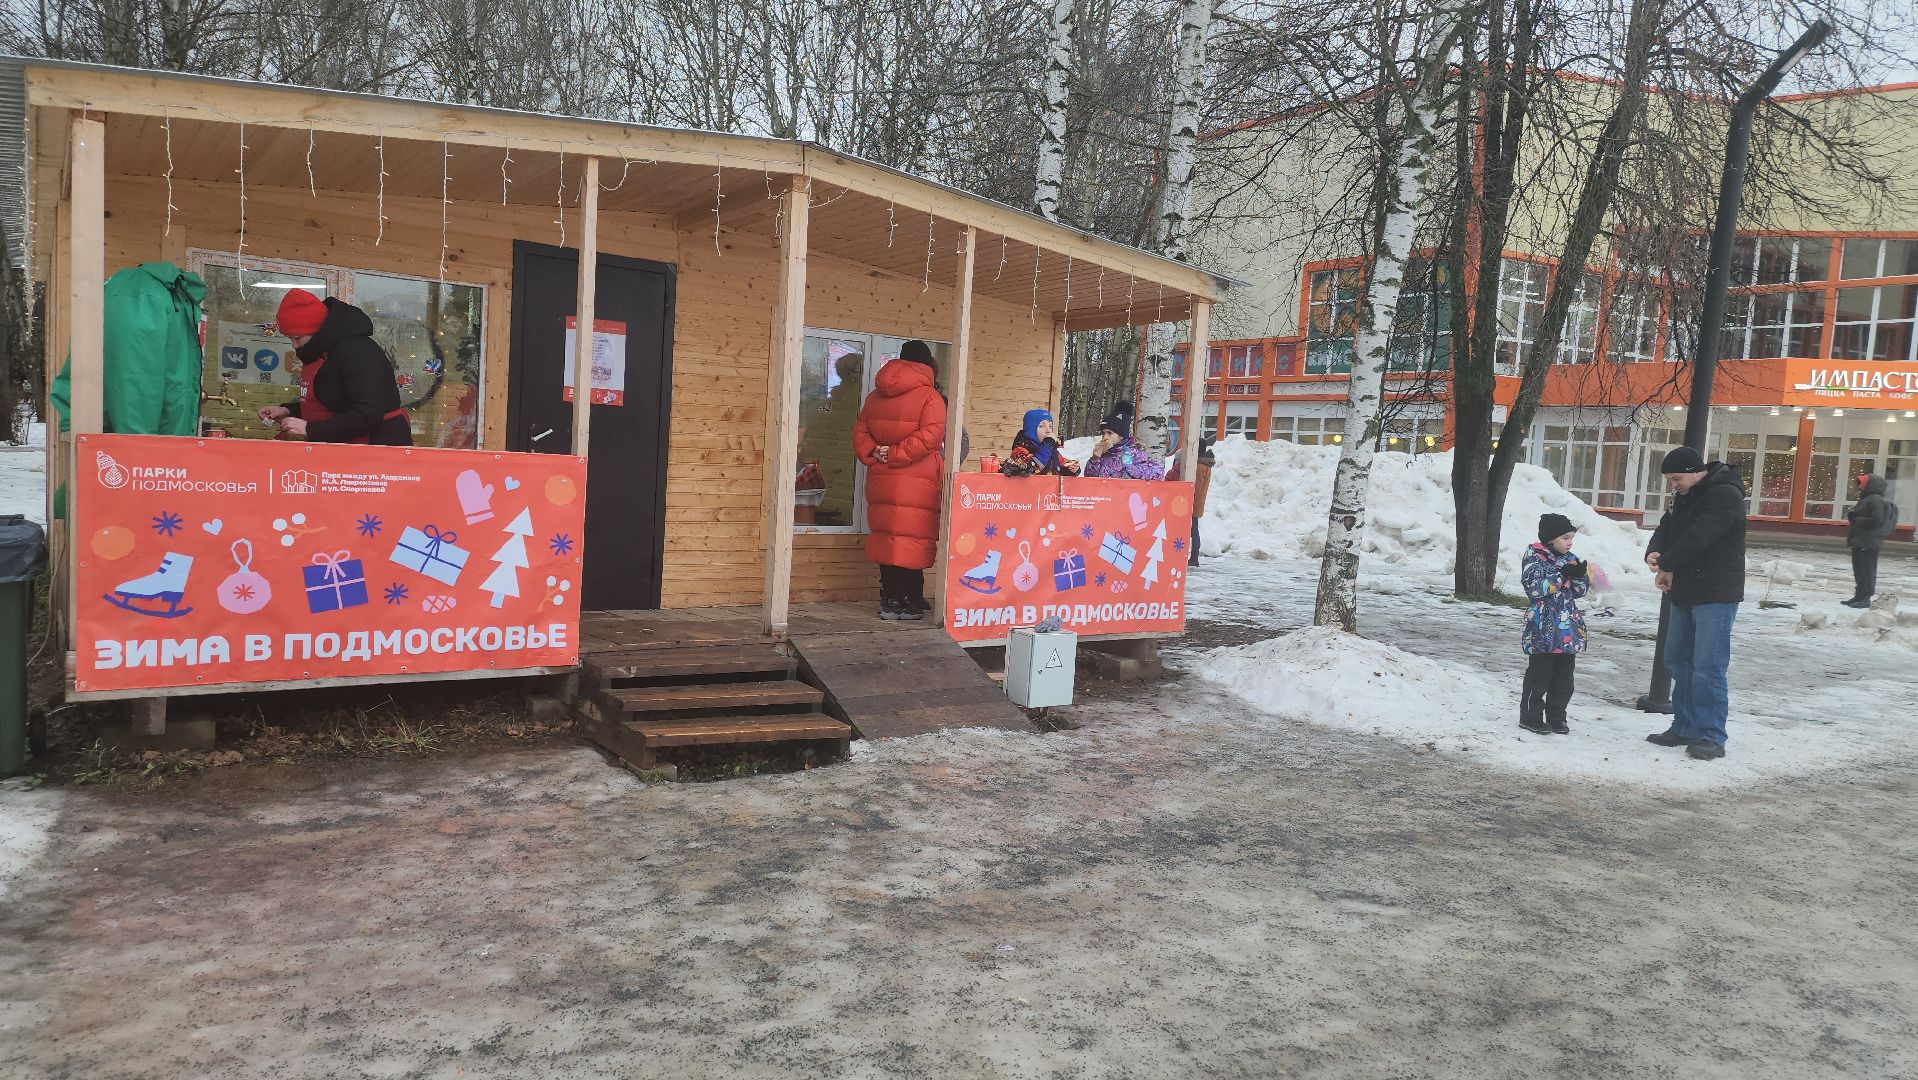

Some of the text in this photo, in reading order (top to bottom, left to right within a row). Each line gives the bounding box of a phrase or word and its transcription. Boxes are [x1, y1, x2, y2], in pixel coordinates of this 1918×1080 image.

[1810, 369, 1918, 390] ИМПАСТ
[1815, 389, 1845, 398] ПИЦЦА
[1889, 392, 1913, 400] КОФЕ
[132, 467, 187, 478] ПАРКИ
[132, 480, 257, 493] ПОДМОСКОВЬЯ
[976, 493, 1002, 501] ПАРКИ
[954, 602, 1179, 627] ЗИМА В ПОДМОСКОВЬЕ
[95, 624, 567, 669] ЗИМА В ПОДМОСКОВЬЕ
